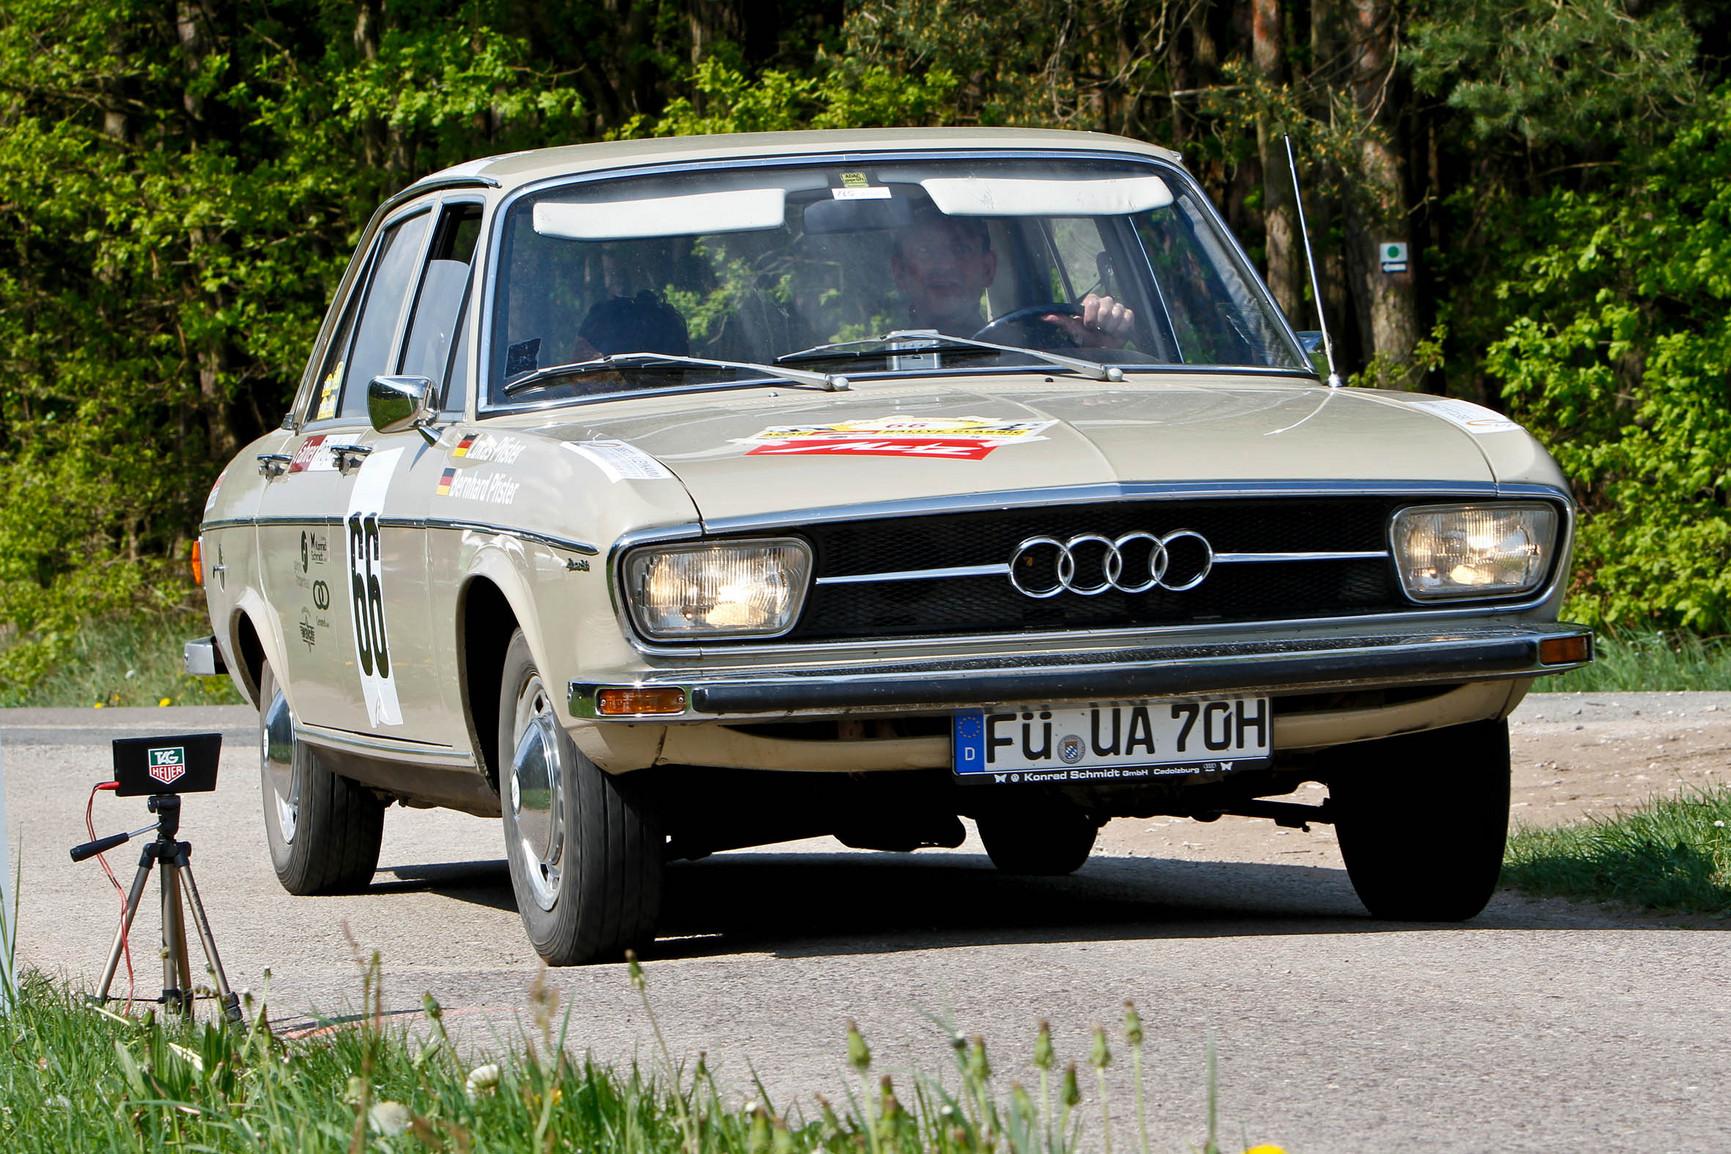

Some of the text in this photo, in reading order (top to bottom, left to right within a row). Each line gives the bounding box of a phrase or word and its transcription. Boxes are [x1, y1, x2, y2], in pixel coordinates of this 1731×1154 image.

[490, 436, 527, 464] Pfister
[449, 468, 520, 505] Bernhard Pfister
[349, 511, 389, 678] 66
[964, 698, 1267, 764] D FÜ UA 70H
[154, 750, 179, 765] TAG
[152, 766, 183, 782] HEUER
[1024, 767, 1200, 782] Konrad Schmidt GmbH Cadolzburg
